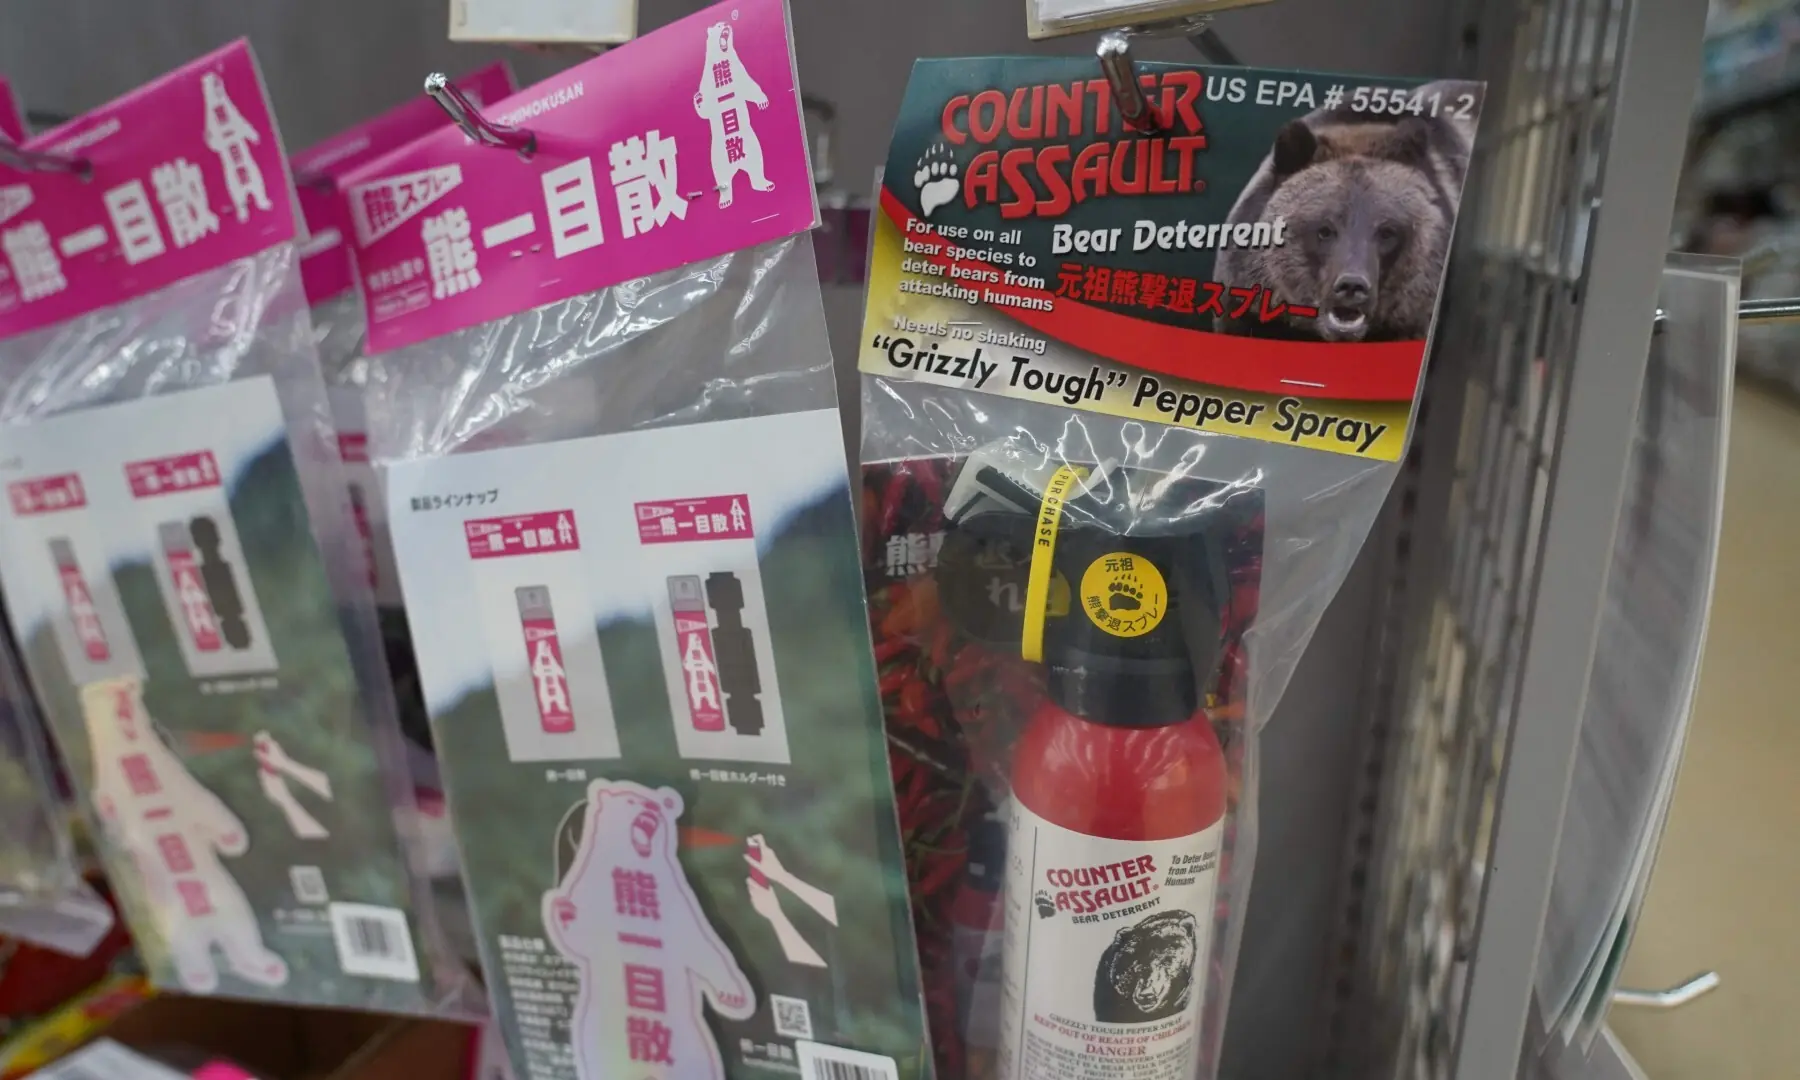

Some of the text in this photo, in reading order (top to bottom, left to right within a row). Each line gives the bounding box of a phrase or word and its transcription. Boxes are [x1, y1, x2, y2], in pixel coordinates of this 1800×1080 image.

[713, 59, 745, 164] 熊一目散
[1205, 76, 1475, 121] US EPA # 55541-2
[2, 158, 220, 302] 熊一目散
[421, 129, 689, 302] 熊一目散
[905, 218, 1022, 245] For use on all
[903, 238, 1037, 268] bear species to
[1052, 215, 1288, 255] Bear Deterrent
[901, 258, 1046, 290] deter bears from
[899, 278, 1054, 312] attacking humans
[1055, 263, 1319, 325] 元祖熊撃退スプレー
[894, 316, 1047, 356] Needs no shaking
[1133, 376, 1266, 426] Pepper
[1272, 398, 1387, 453] Spray
[1038, 473, 1070, 548] PURCHASE
[1105, 557, 1135, 573] 元祖
[1086, 593, 1159, 633] 熊撃退スプレー
[1046, 854, 1157, 889] COUNTER
[1168, 866, 1187, 876] from
[1172, 854, 1181, 865] To
[1055, 877, 1152, 915] ASSAULT
[1072, 897, 1161, 924] BEAR DETERRENT
[611, 866, 675, 1067] 熊一目散
[1049, 1012, 1184, 1036] GRIZZLY TOUGH PEPPER SPRAY
[1058, 1025, 1080, 1040] OUT
[1081, 1032, 1098, 1043] OF
[1098, 1035, 1135, 1045] REACH
[1136, 1034, 1150, 1044] OF
[1085, 1043, 1147, 1057] DANGER
